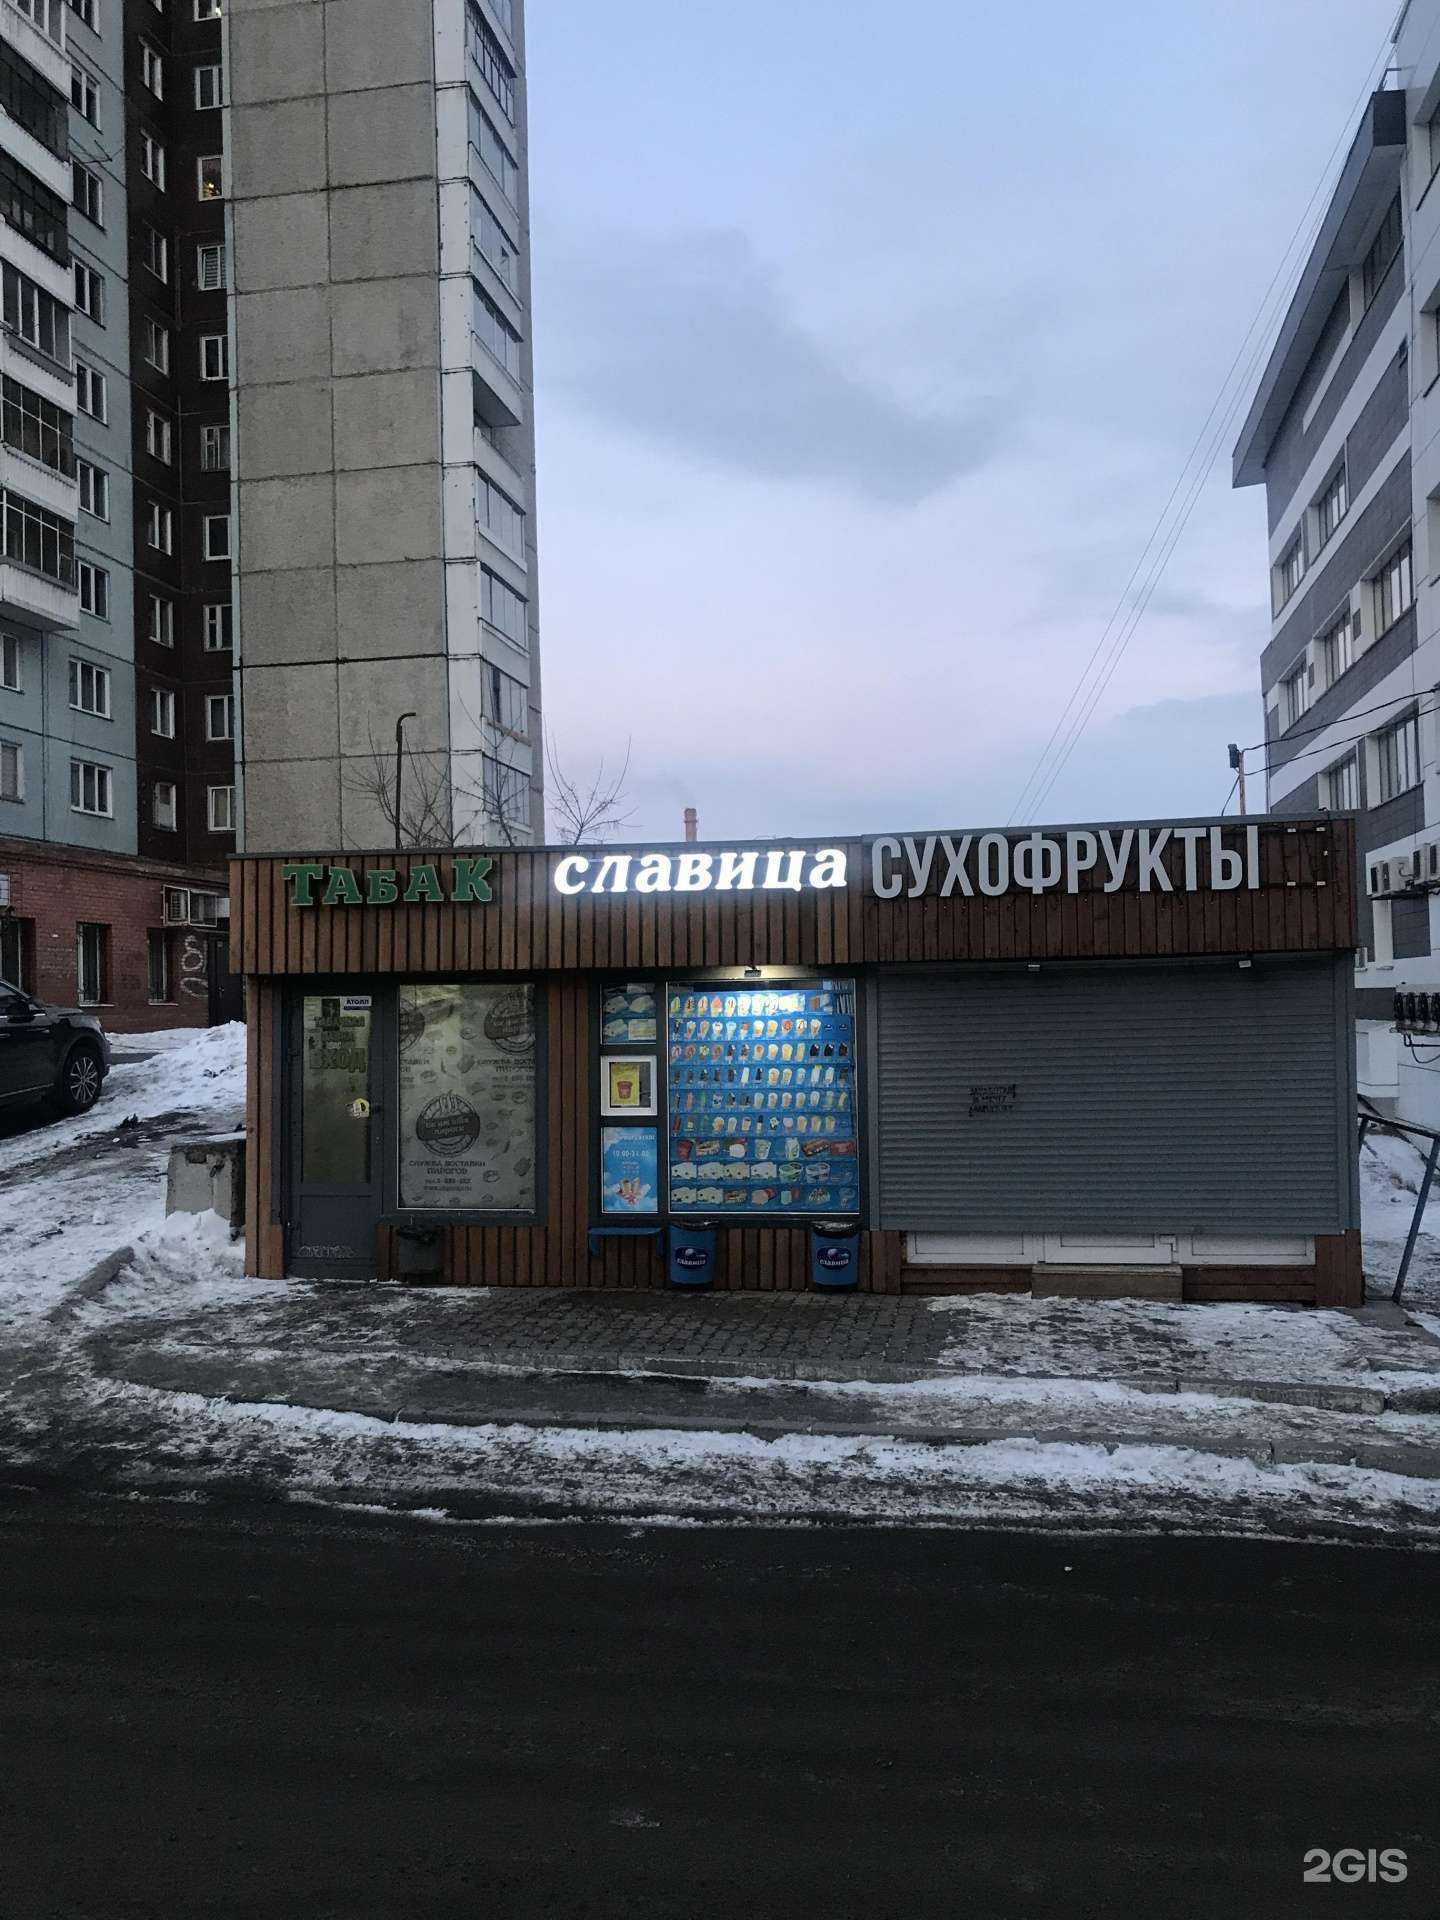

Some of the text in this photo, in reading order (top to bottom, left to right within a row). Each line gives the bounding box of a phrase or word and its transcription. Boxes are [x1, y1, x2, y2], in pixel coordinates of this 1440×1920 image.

[281, 857, 494, 905] ТАБАК
[553, 848, 848, 895] славица
[871, 825, 1260, 899] СУХОФРУКТЫ
